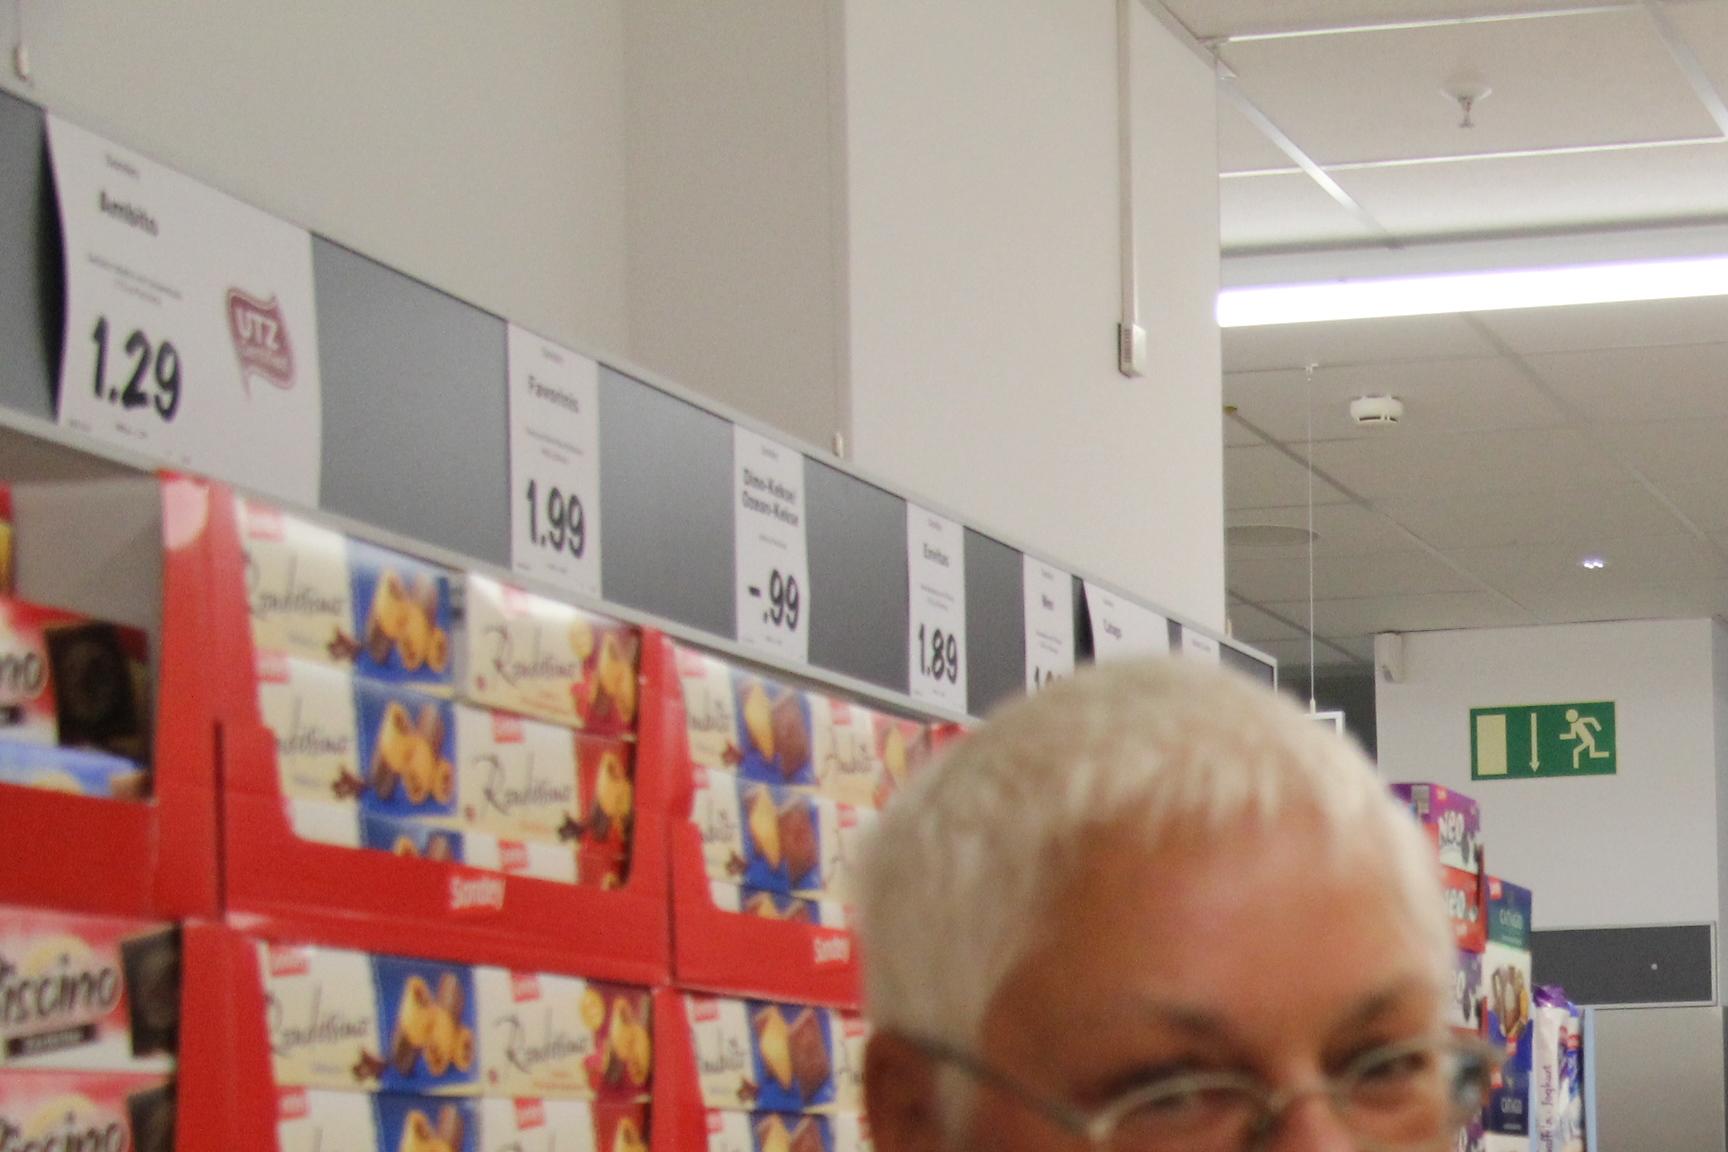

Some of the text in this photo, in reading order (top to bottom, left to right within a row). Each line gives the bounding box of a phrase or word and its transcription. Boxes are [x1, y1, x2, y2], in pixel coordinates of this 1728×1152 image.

[235, 306, 280, 351] UTZ
[91, 314, 182, 423] 1.29
[525, 478, 586, 560] 1.99
[918, 622, 958, 686] 1.89
